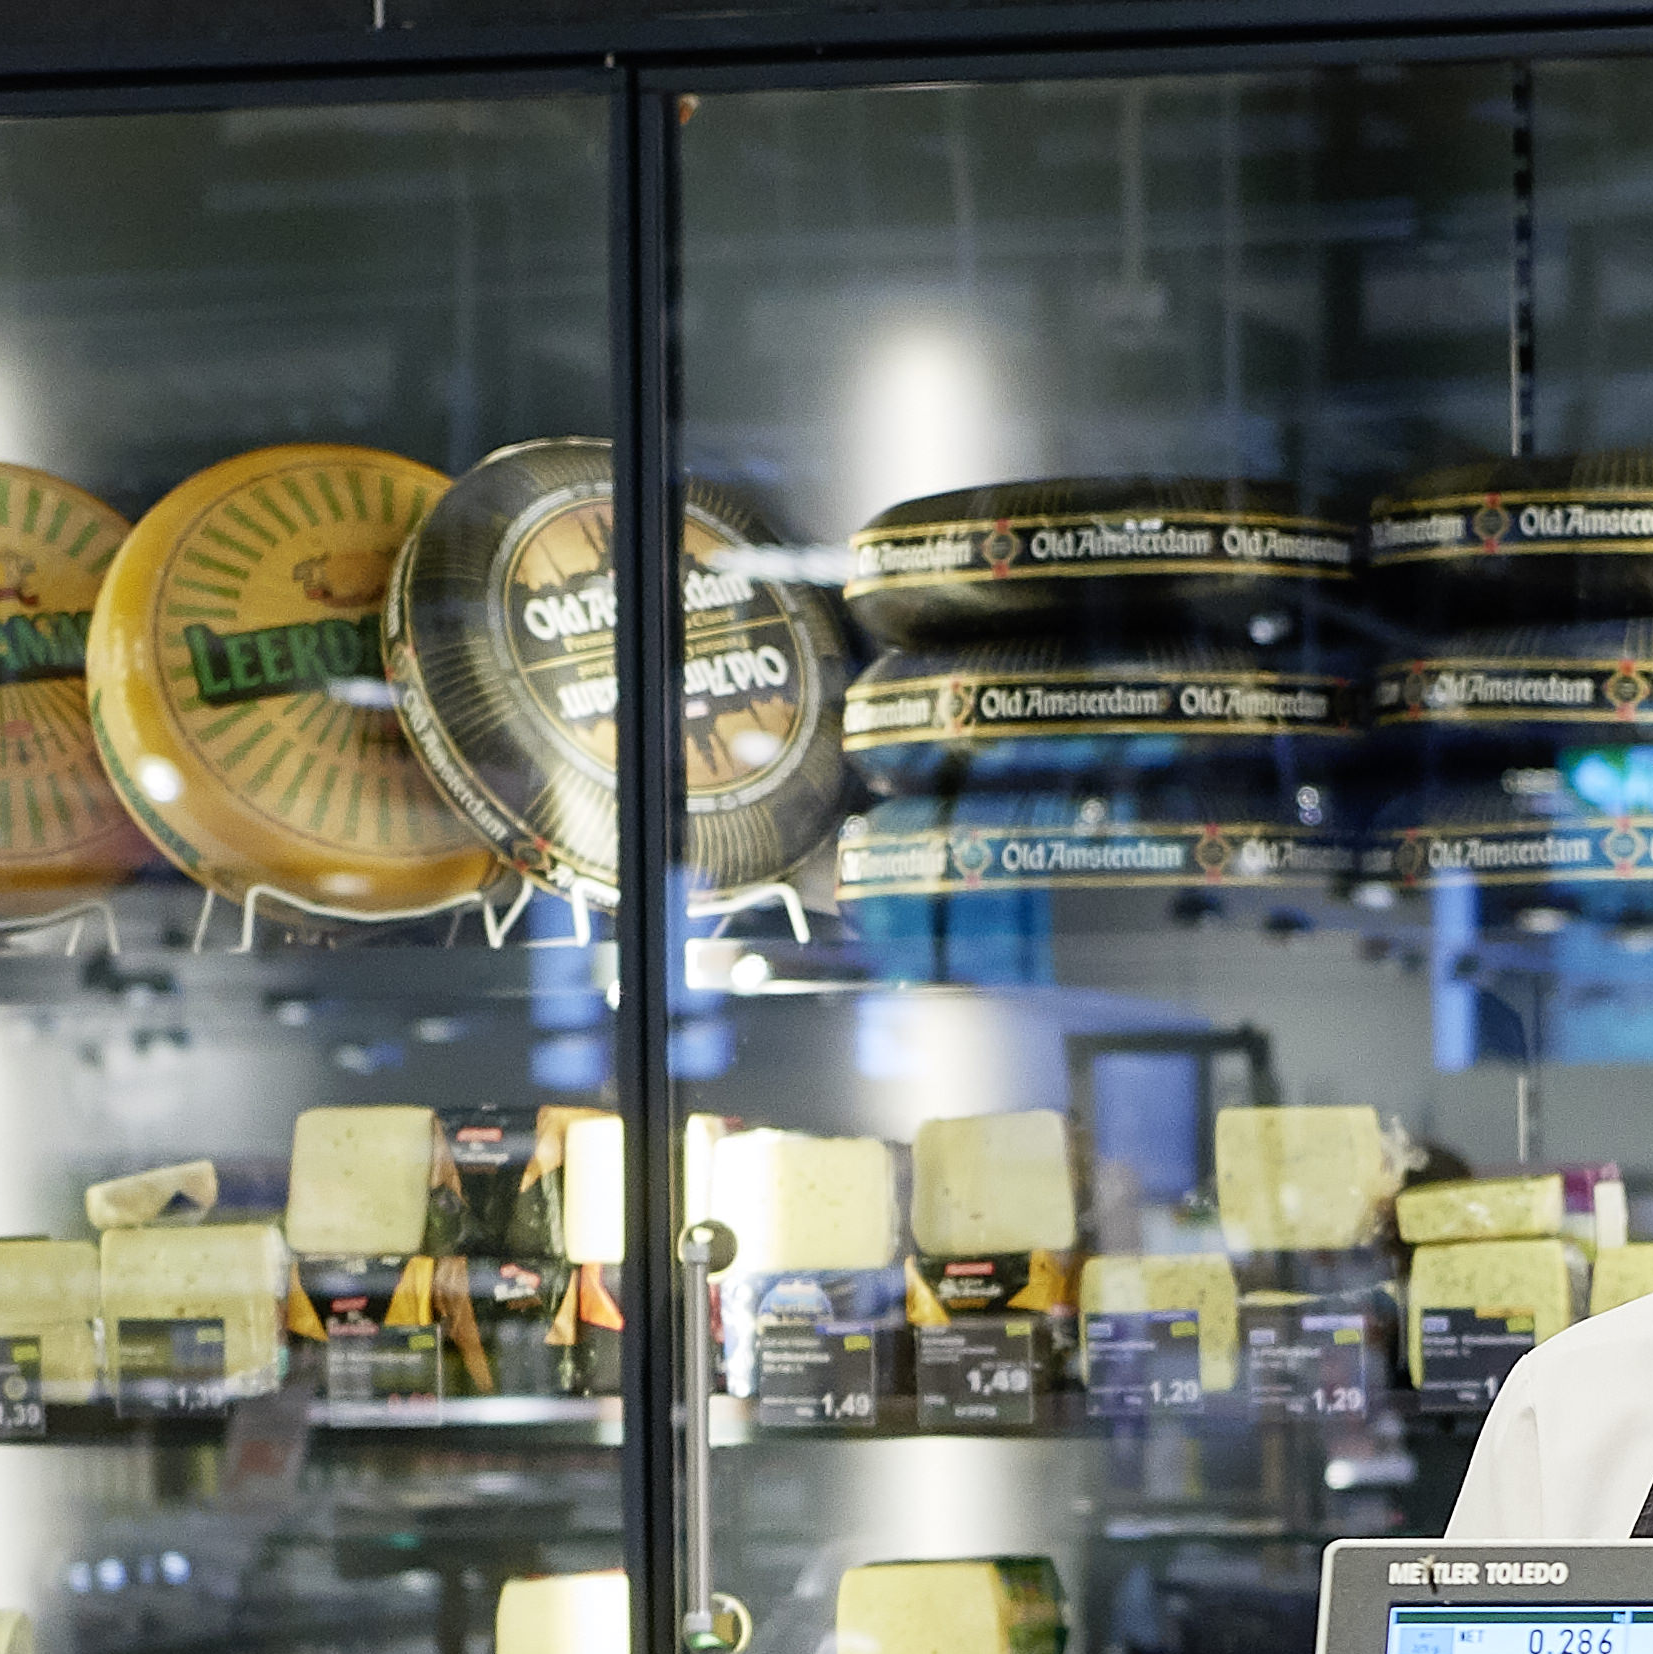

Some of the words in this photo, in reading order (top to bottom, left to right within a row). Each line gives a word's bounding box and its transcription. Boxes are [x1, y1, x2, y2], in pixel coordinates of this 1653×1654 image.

[1520, 506, 1564, 536] Old
[1030, 530, 1075, 560] Old
[1077, 526, 1212, 559] Amsterdam
[1223, 526, 1263, 557] Old
[980, 686, 1023, 719] Old
[1025, 685, 1159, 717] Amsterdam
[1179, 685, 1223, 716] Old
[1002, 842, 1045, 871] Old
[1048, 841, 1183, 870] Amsterdam
[1464, 836, 1591, 867] Amsterdam
[1388, 1562, 1479, 1585] METTLER
[1485, 1562, 1569, 1585] TOLEDO
